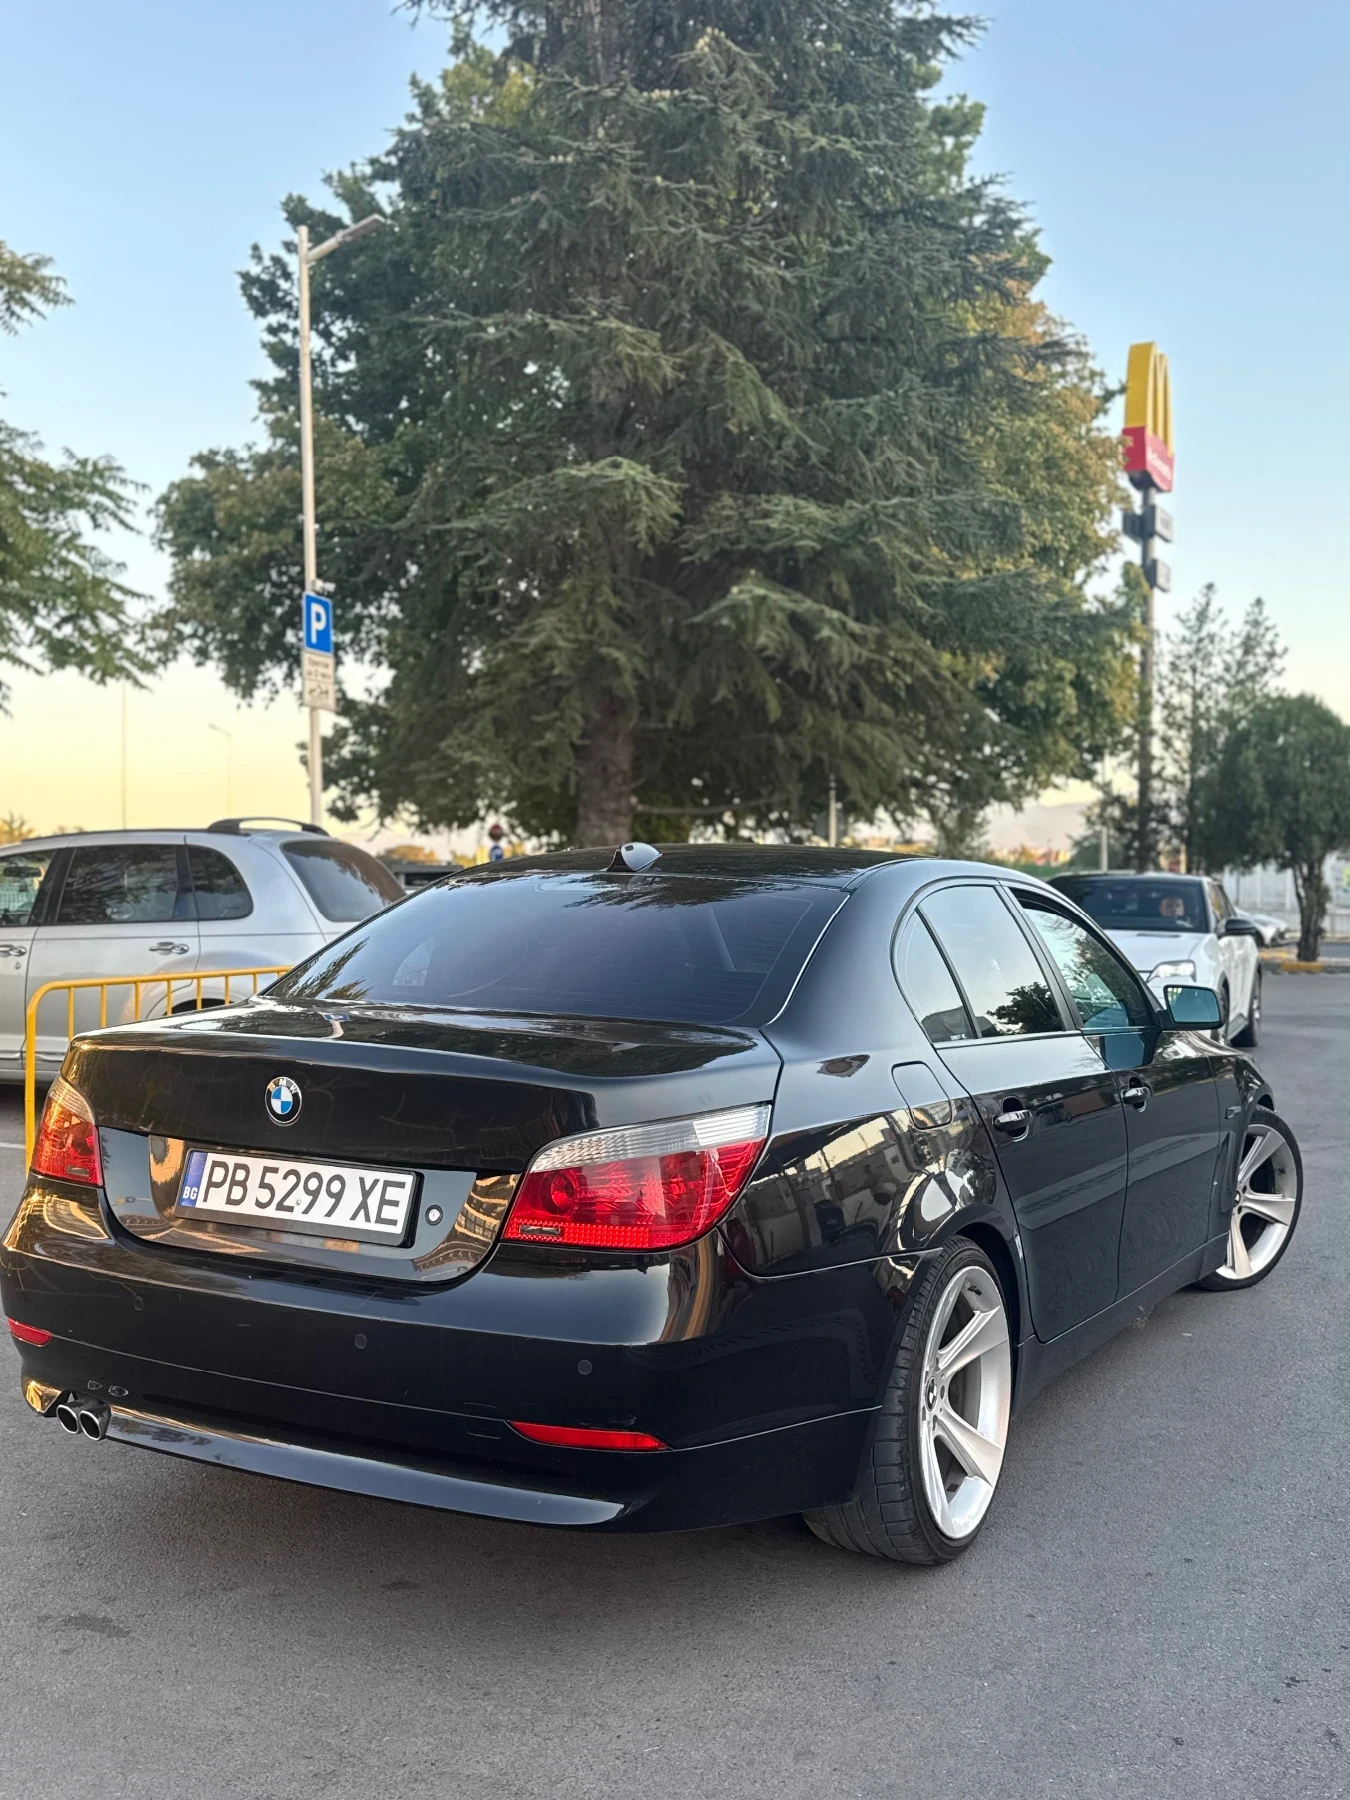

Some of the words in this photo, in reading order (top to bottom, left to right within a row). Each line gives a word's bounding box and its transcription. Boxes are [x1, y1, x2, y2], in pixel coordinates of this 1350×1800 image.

[310, 602, 327, 644] P
[268, 1078, 299, 1095] BMW
[182, 1186, 198, 1200] BG
[203, 1160, 250, 1206] PB
[254, 1166, 347, 1217] 5299
[350, 1176, 406, 1227] XE
